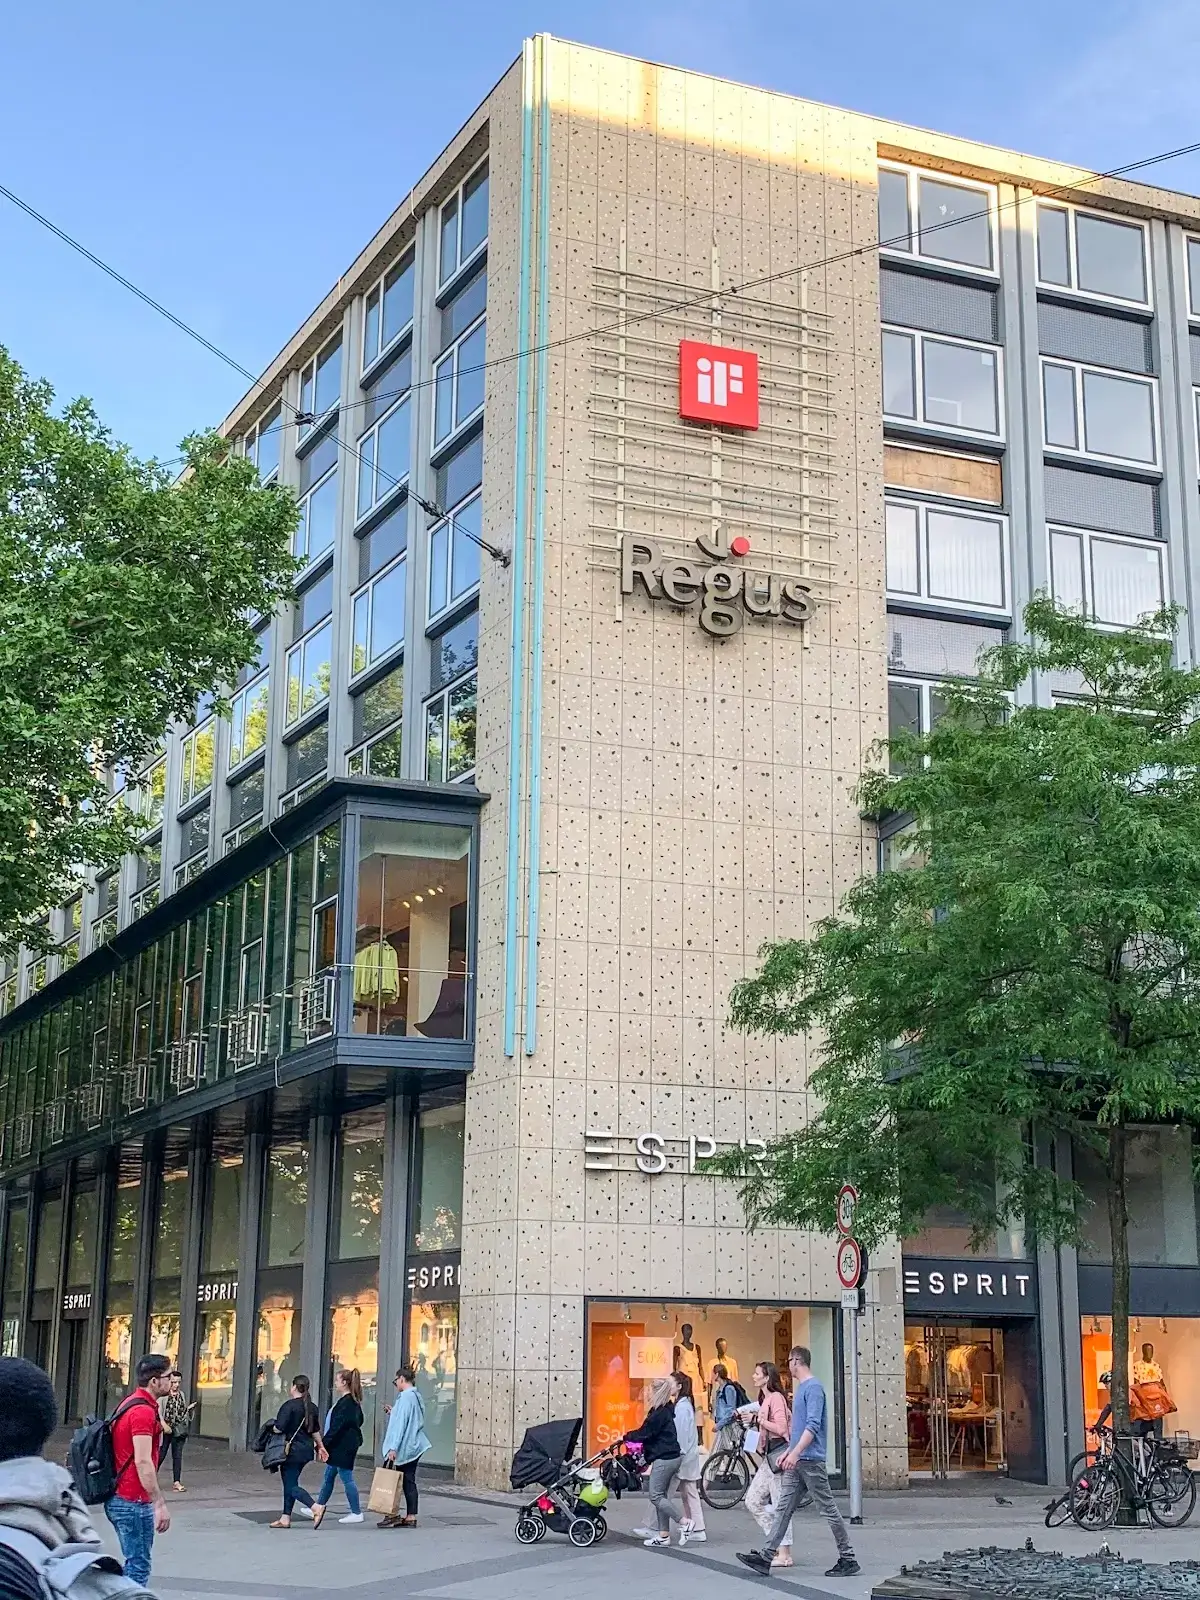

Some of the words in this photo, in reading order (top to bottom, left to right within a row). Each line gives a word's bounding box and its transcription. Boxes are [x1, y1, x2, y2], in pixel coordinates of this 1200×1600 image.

[621, 534, 817, 638] Regus
[584, 1130, 838, 1179] ESPR
[408, 1264, 461, 1289] ESPRI
[904, 1271, 1030, 1297] ESPRIT
[63, 1293, 92, 1310] ESPRIT
[197, 1282, 238, 1302] ESPRIT
[636, 1350, 668, 1364] 50%
[596, 1423, 626, 1443] Sal
